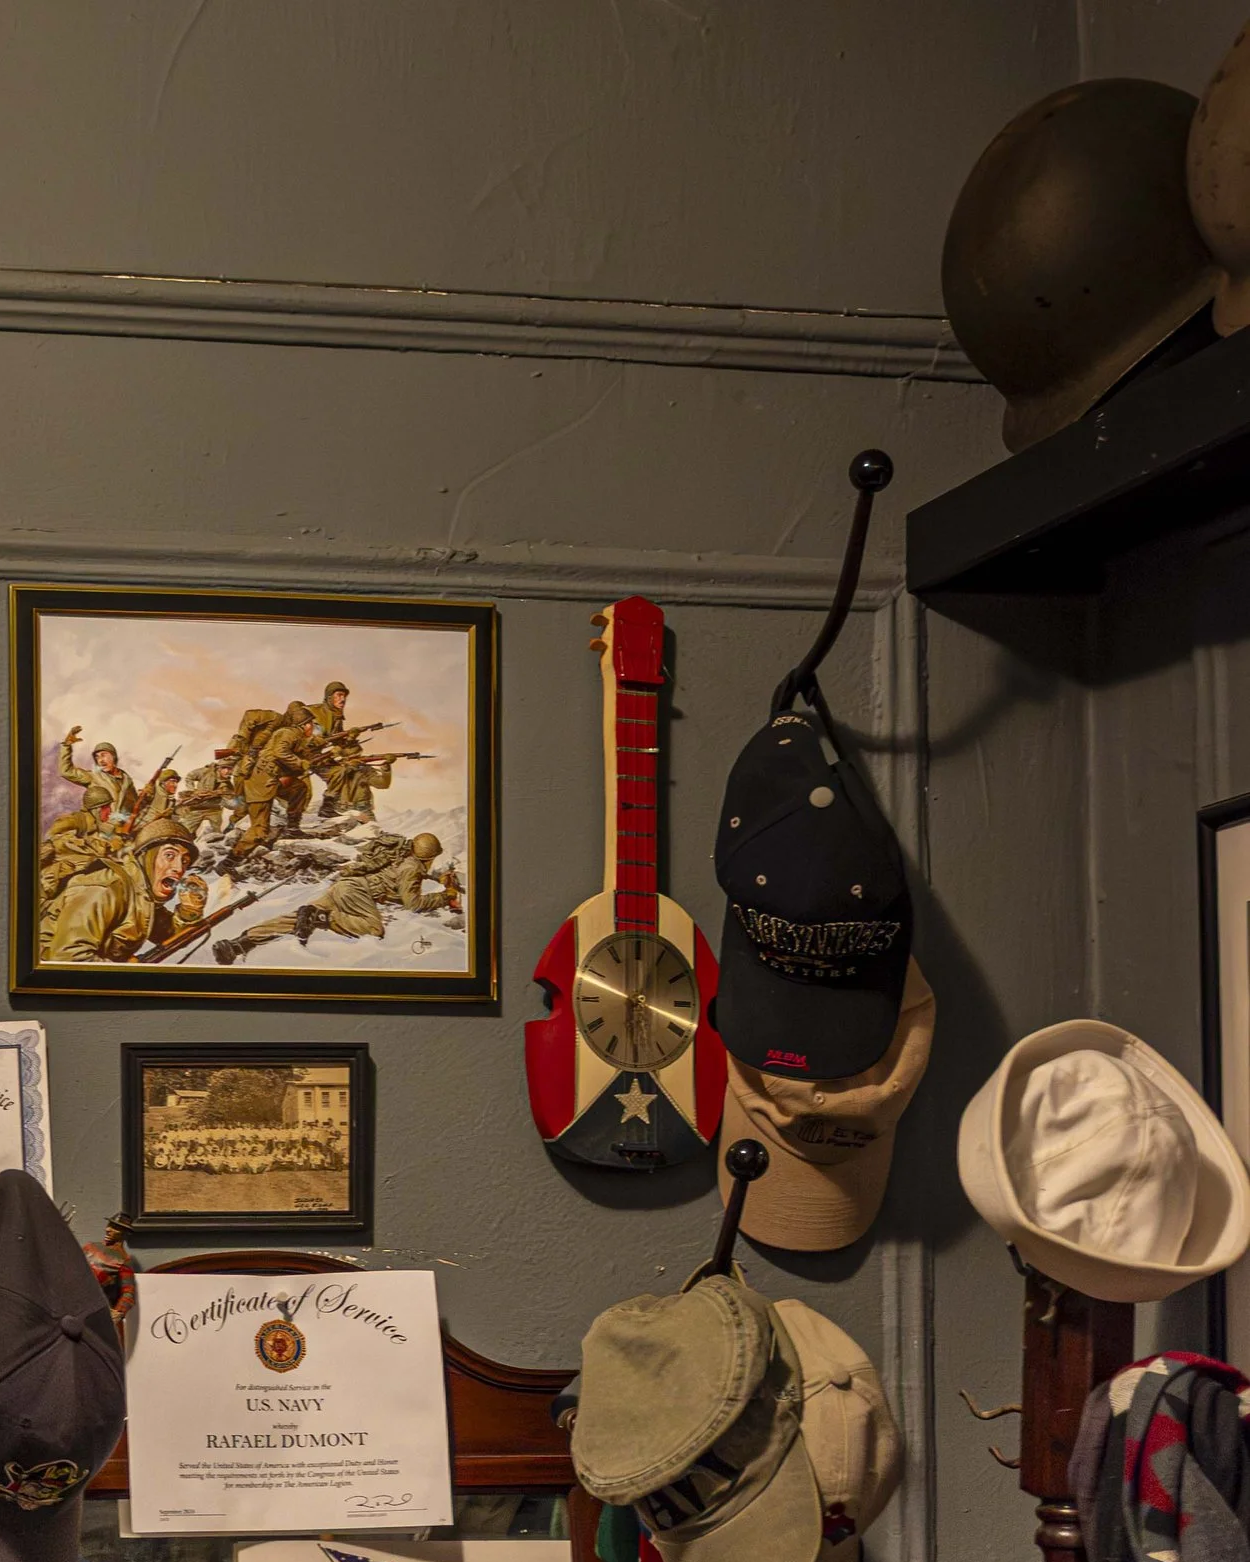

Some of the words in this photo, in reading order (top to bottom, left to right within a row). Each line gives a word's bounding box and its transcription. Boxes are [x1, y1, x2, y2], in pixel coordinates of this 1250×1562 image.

[766, 1050, 806, 1063] NLBM
[151, 1287, 279, 1344] Certificate
[315, 1283, 408, 1345] Service
[248, 1384, 288, 1393] distinguished
[246, 1398, 274, 1412] U.S.
[279, 1398, 324, 1412] NAVY
[272, 1423, 299, 1431] whereby
[206, 1434, 277, 1449] RAFAEL
[282, 1432, 368, 1448] DUMONT
[179, 1462, 200, 1470] Served
[255, 1462, 263, 1471] of
[307, 1459, 344, 1468] exceptional
[345, 1459, 362, 1468] Duty
[268, 1471, 285, 1480] forth
[286, 1471, 294, 1480] by
[307, 1470, 336, 1479] Congress
[337, 1470, 344, 1479] of
[357, 1468, 379, 1476] United
[224, 1482, 234, 1490] for
[235, 1481, 274, 1490] membership
[284, 1480, 296, 1488] The
[297, 1480, 329, 1488] American
